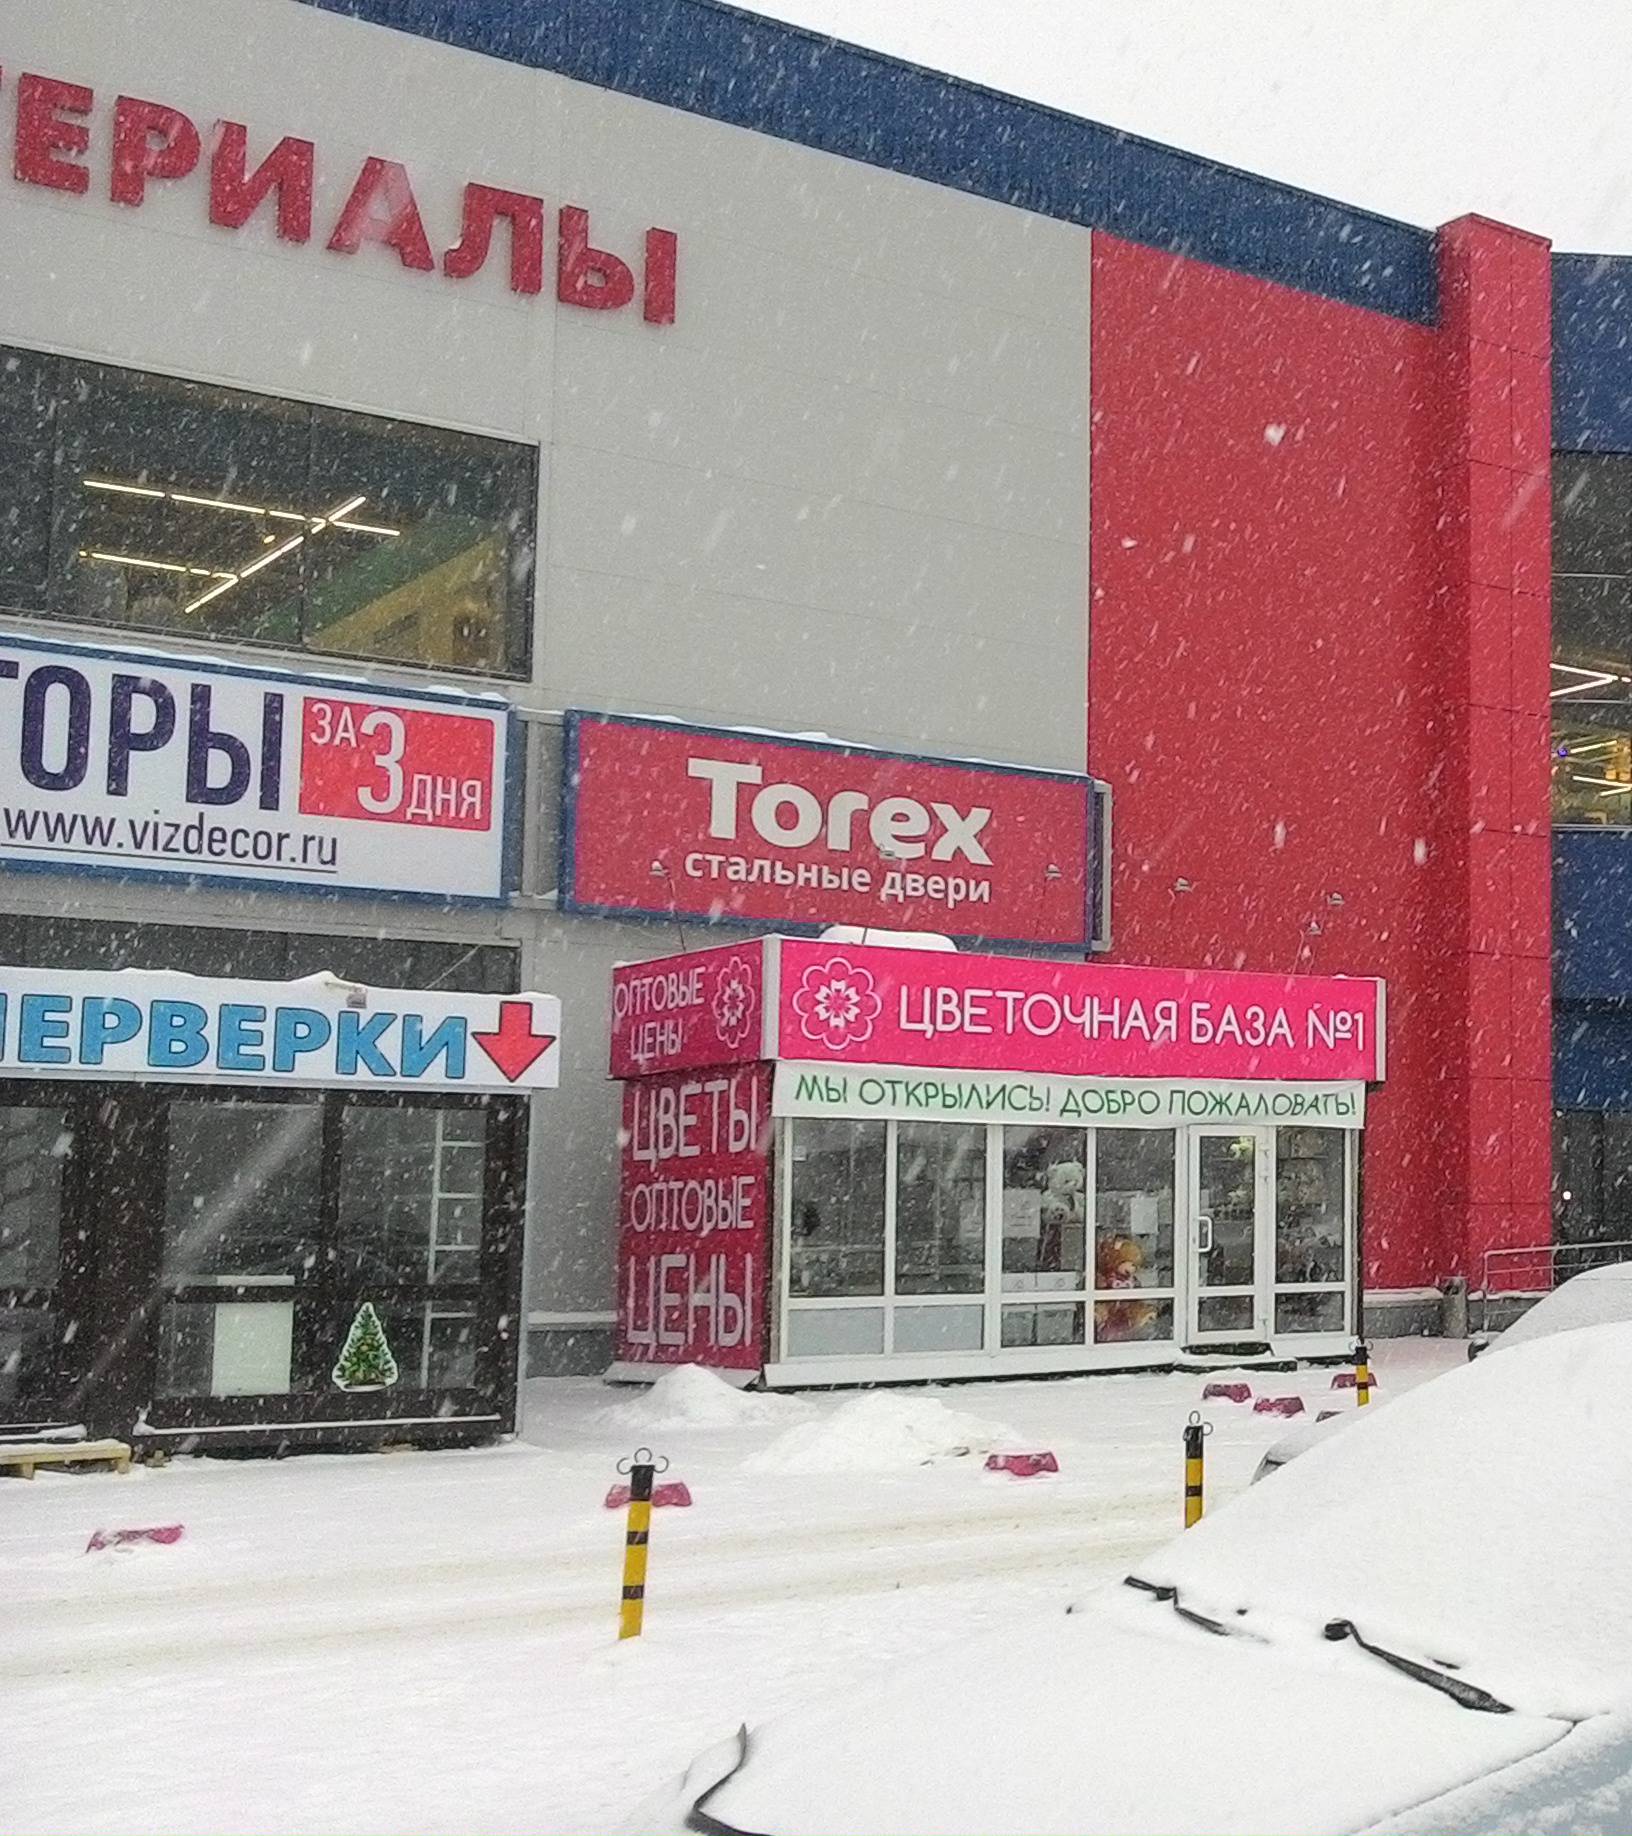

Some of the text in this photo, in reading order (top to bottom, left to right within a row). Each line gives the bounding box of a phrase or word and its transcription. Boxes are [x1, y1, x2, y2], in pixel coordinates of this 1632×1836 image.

[0, 65, 678, 325] ЕРИАЛЫ
[310, 703, 482, 822] ЗА 3 ДНЯ
[3, 808, 338, 868] www.vizdecor.ru
[687, 758, 992, 866] Torex
[685, 850, 990, 908] стальные двери
[614, 967, 705, 1019] ОПТОВЫЕ
[899, 986, 1364, 1051] ЦВЕТОЧНАЯ БАЗА №1
[0, 993, 467, 1079] ЕРВЕРКИ
[630, 1021, 682, 1062] ЦЕНЫ
[632, 1076, 757, 1169] ЦВЕТЫ
[795, 1074, 1356, 1117] МЫ ОТКРЫЛИСЬ! ДОБРО ПОЖАЛОВАТЬ!
[631, 1175, 755, 1235] ОПТОВЫЕ
[627, 1252, 752, 1360] ЦЕНЫ
